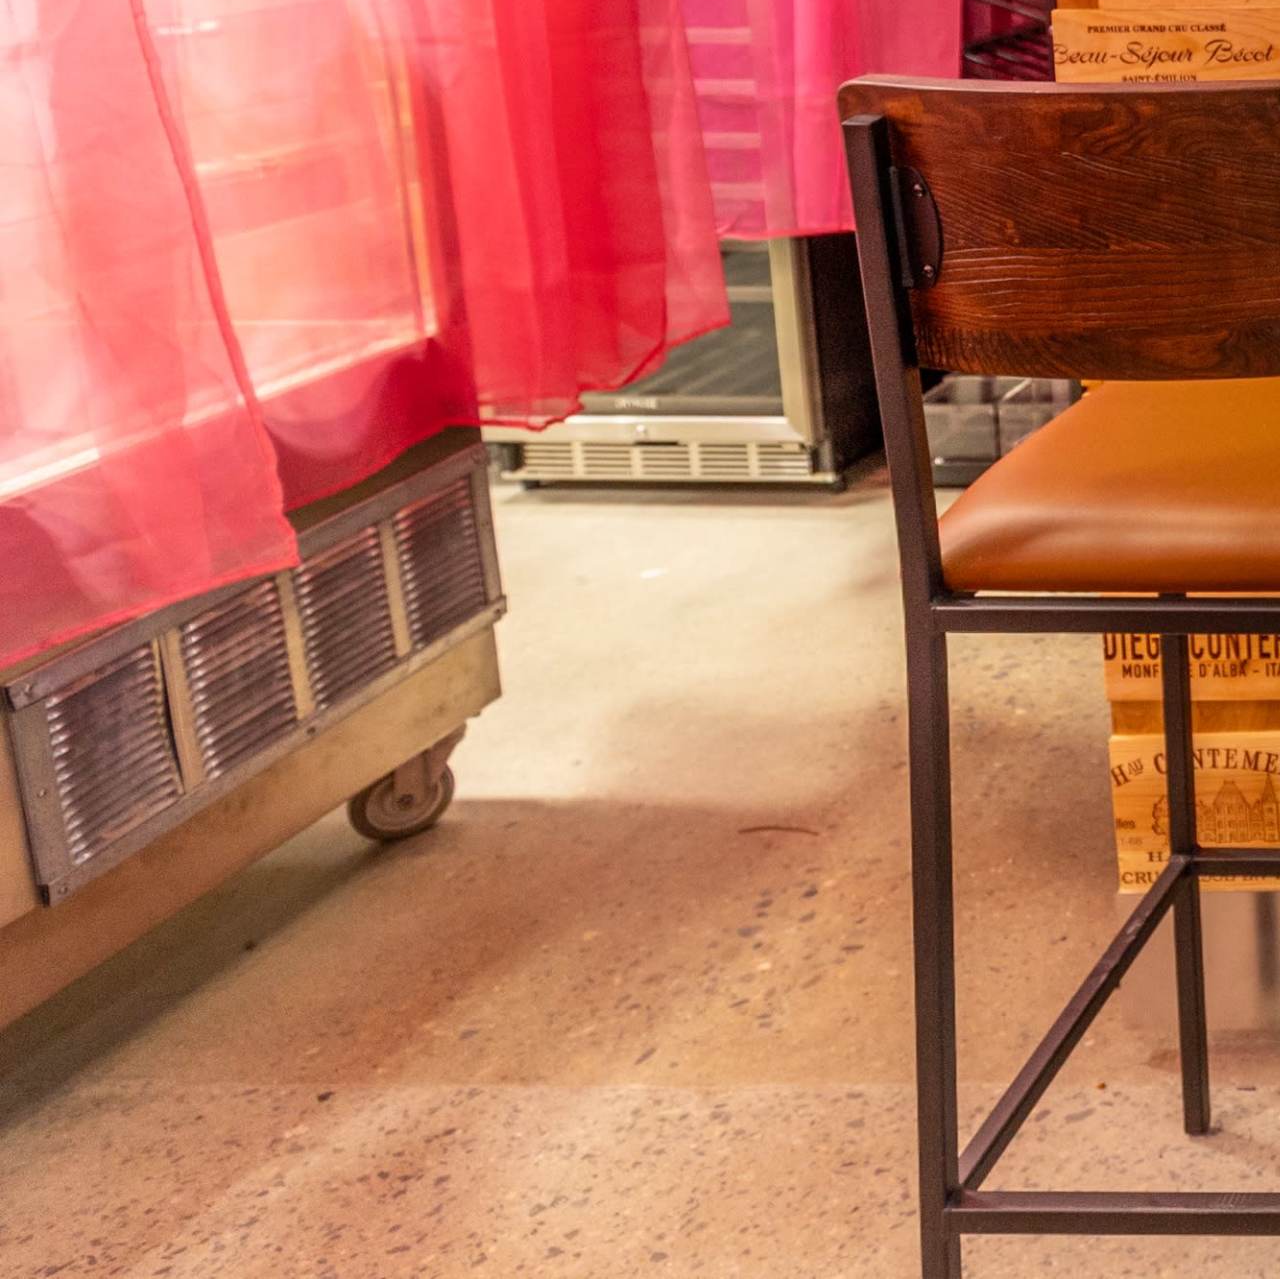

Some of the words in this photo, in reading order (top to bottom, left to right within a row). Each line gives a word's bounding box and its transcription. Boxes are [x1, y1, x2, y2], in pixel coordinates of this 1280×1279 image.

[1087, 25, 1130, 34] PREMIER
[1132, 24, 1166, 33] GRAND
[1168, 24, 1188, 33] CRU
[1102, 633, 1160, 661] DIEG
